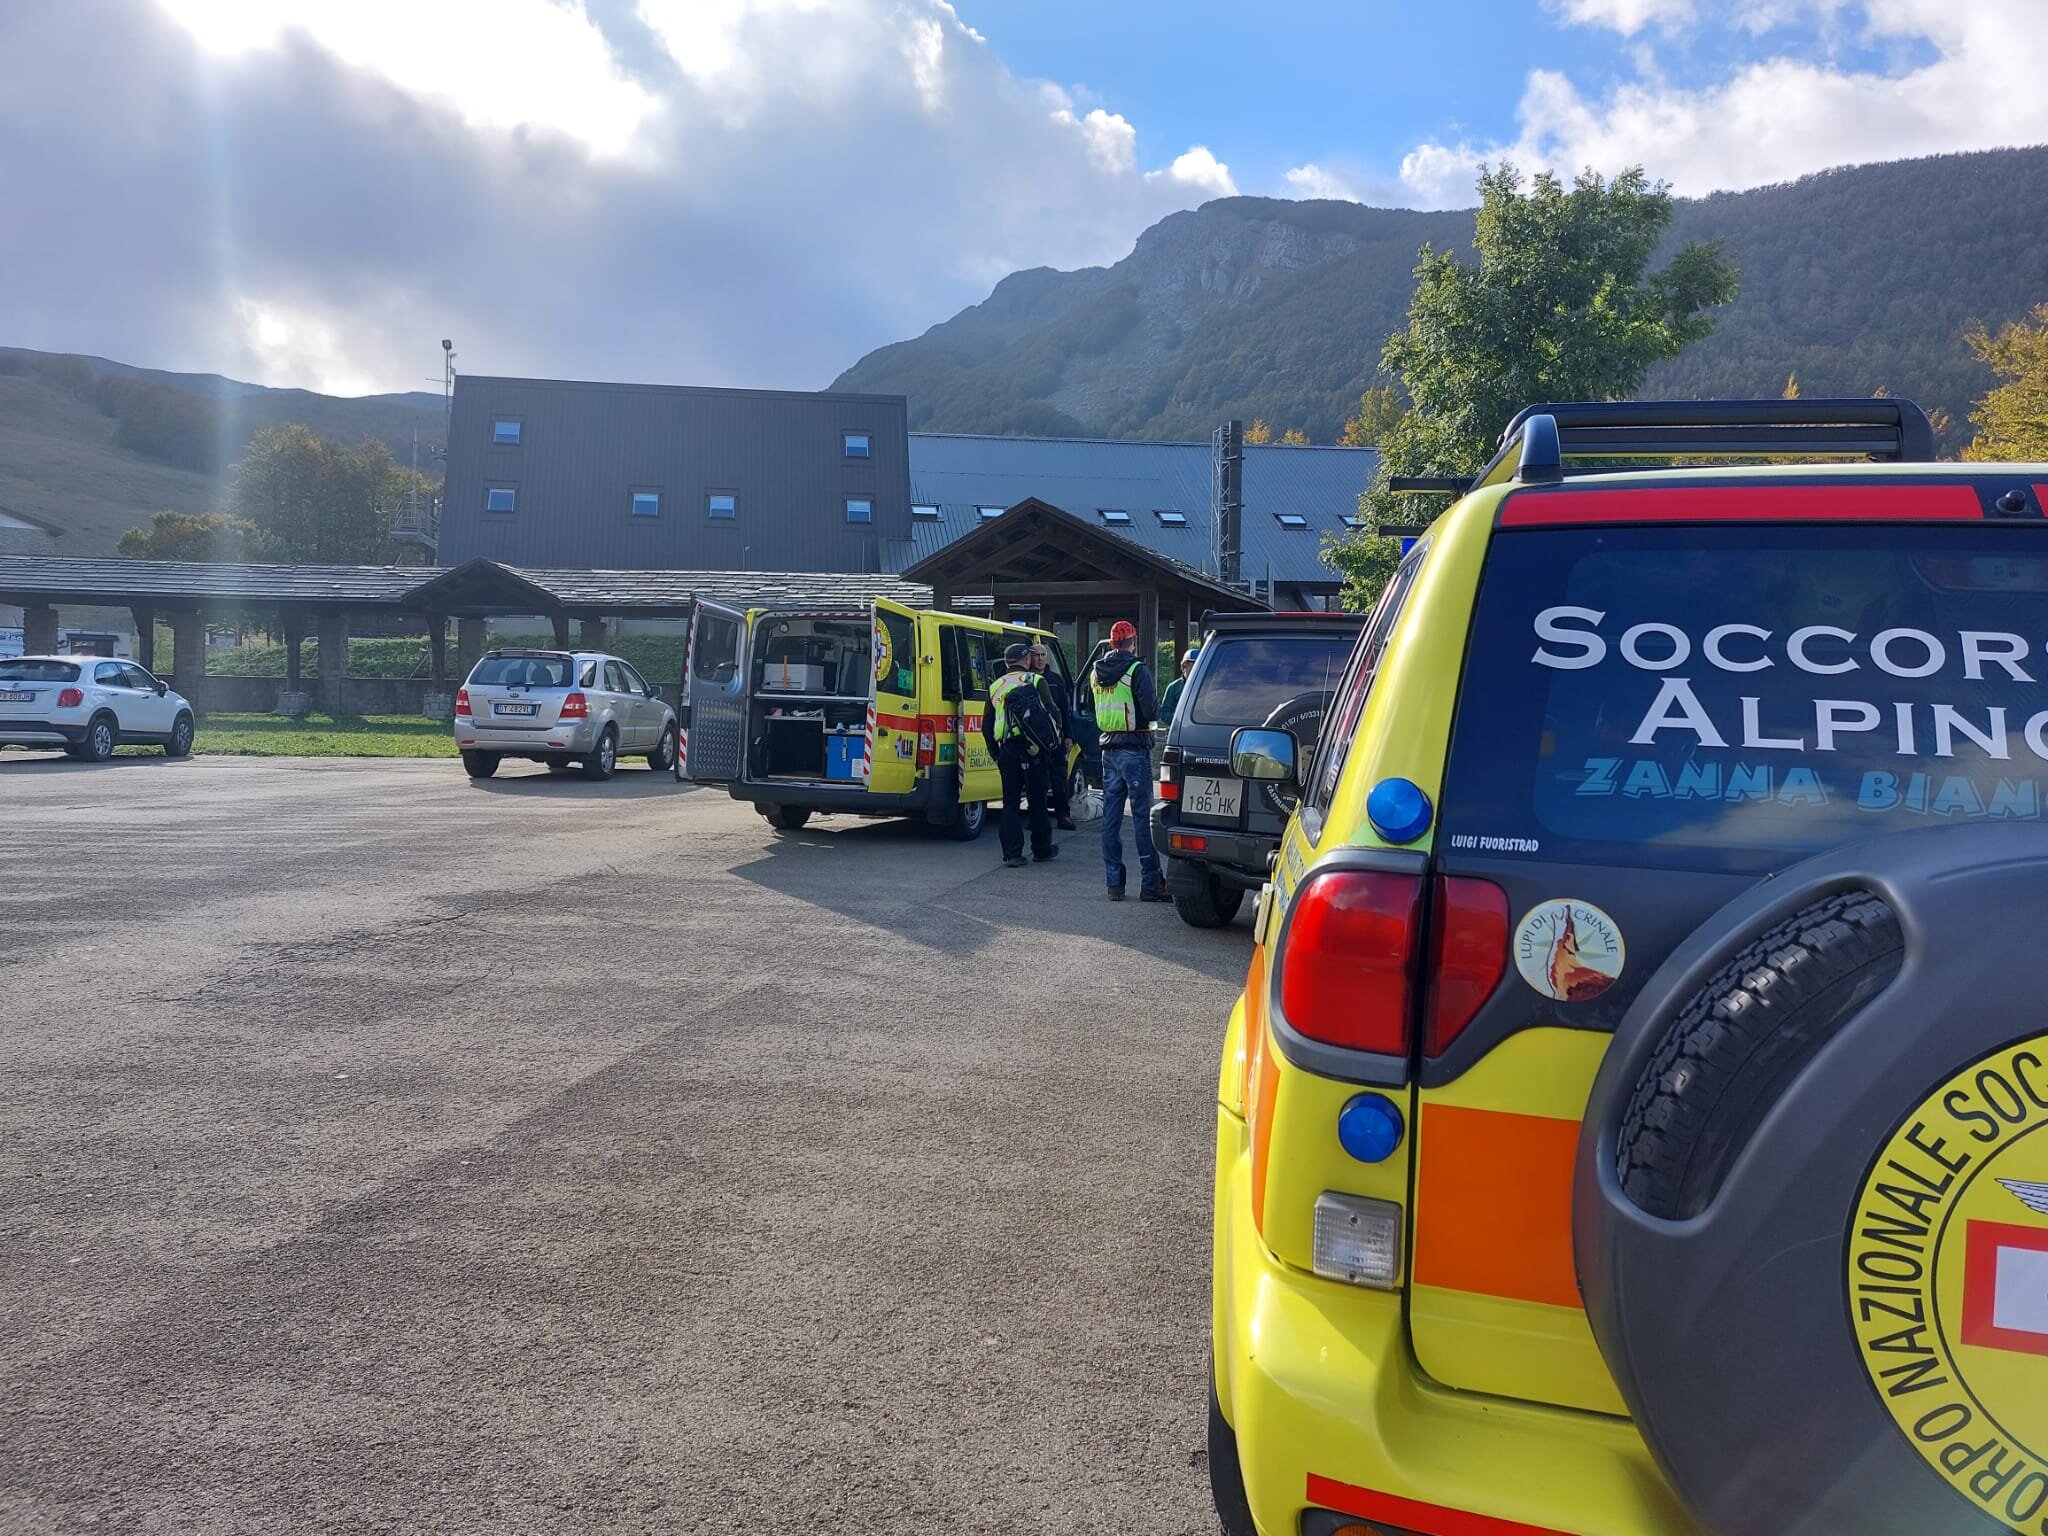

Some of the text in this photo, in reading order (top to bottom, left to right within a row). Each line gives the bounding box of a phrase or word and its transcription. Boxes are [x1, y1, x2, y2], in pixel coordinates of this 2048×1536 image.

[1531, 605, 2048, 682] SOCCOR
[1190, 796, 1236, 814] 186 HK
[1205, 779, 1221, 796] ZA
[1576, 757, 2048, 819] ZANNA BIAN
[1451, 834, 1539, 852] LUIGI FUORISTRAD
[1521, 908, 1618, 959] LUPI DI CRINALE
[1857, 1121, 1972, 1397] NAZIONALE
[1913, 1403, 2048, 1536] ORPO
